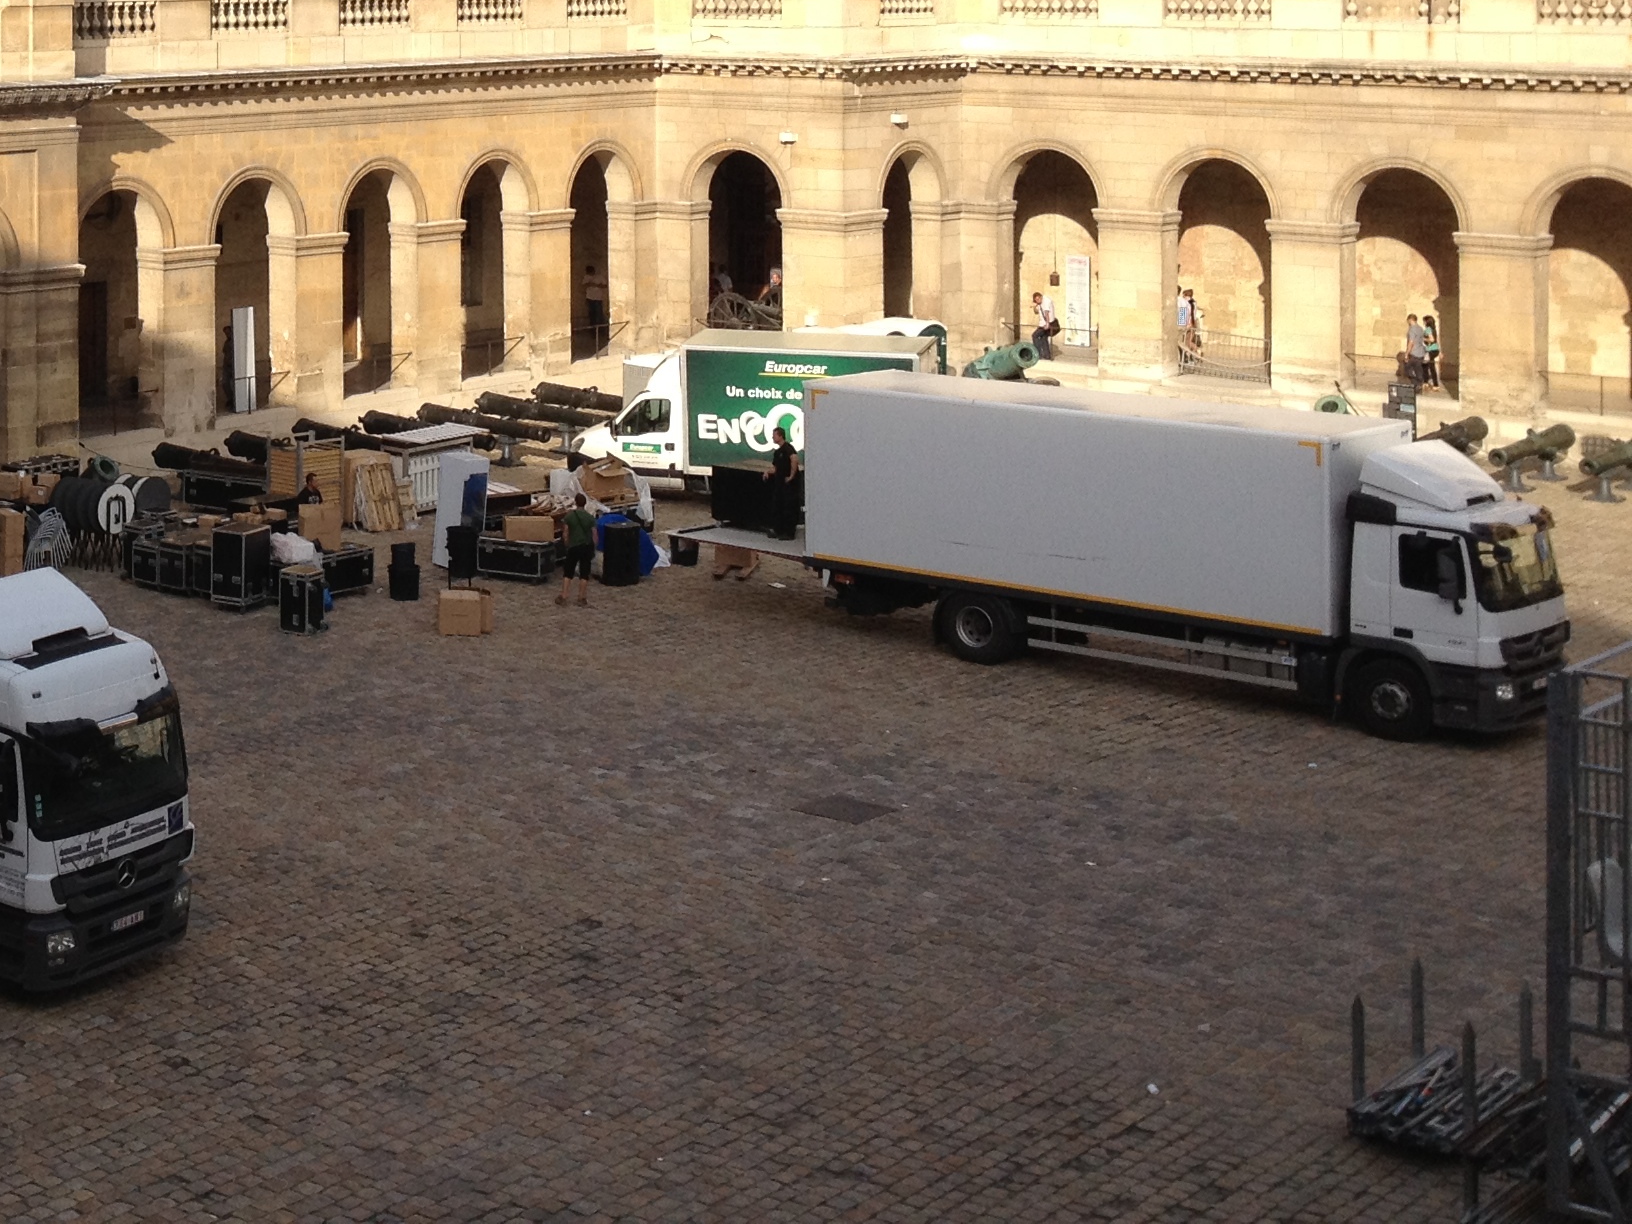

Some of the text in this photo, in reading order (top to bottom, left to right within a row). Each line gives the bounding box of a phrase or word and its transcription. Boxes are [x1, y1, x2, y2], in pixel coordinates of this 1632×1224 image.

[764, 360, 828, 378] Europcar
[725, 385, 804, 401] Un choix de
